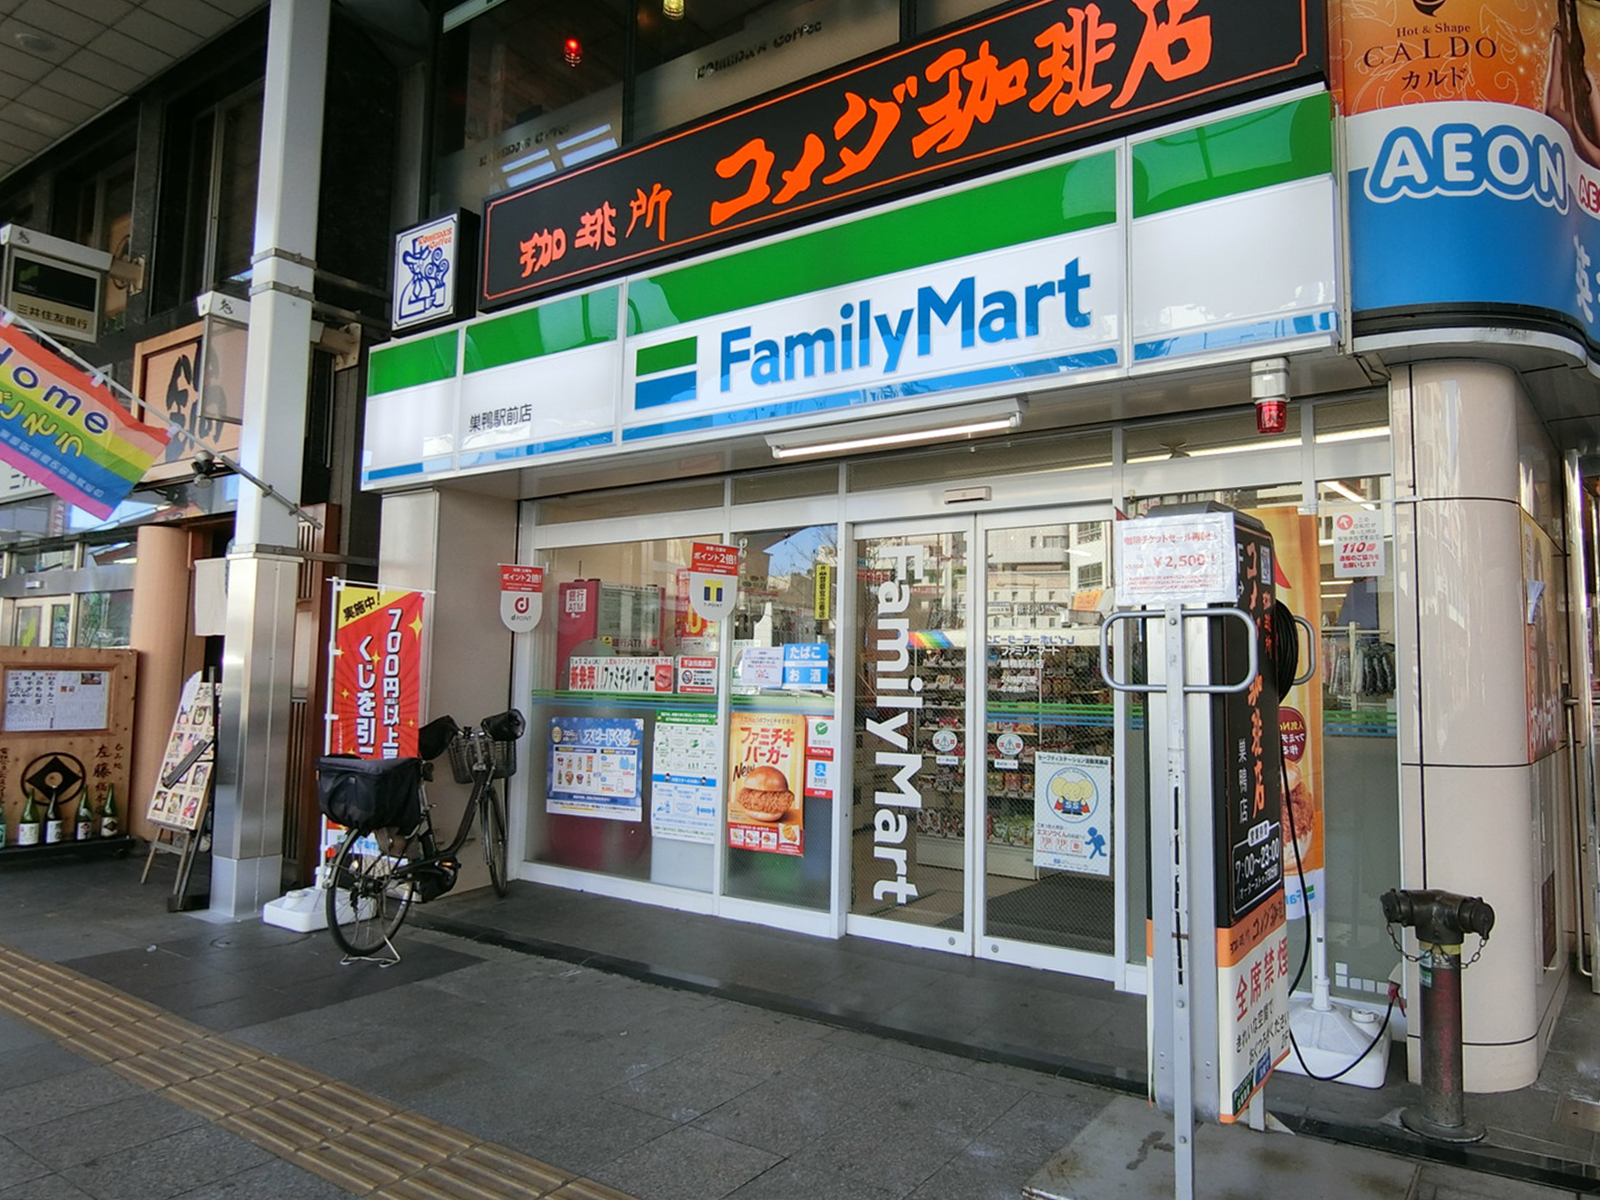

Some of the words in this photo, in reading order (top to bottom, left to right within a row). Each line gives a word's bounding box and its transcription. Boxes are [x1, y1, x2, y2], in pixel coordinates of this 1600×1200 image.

[1396, 25, 1420, 38] Hot
[1422, 25, 1431, 34] &
[1435, 22, 1470, 34] Shape
[1363, 36, 1497, 69] CALDO
[1402, 67, 1467, 90] カルド
[1368, 123, 1567, 212] AEON
[17, 304, 88, 330] 三井住友銀行
[719, 257, 1091, 394] FamilyMart
[469, 404, 532, 432] 巣鴨駅前店
[343, 591, 380, 622] 実施中!
[789, 645, 821, 659] たばこ
[1001, 646, 1060, 656] ファミリーマート
[356, 635, 377, 754] くじを引
[740, 727, 795, 747] ファミチキ
[866, 545, 923, 904] FamilyMart
[744, 745, 789, 764] バーガー
[732, 762, 756, 782] New
[1236, 935, 1289, 1022] 全席禁煙
